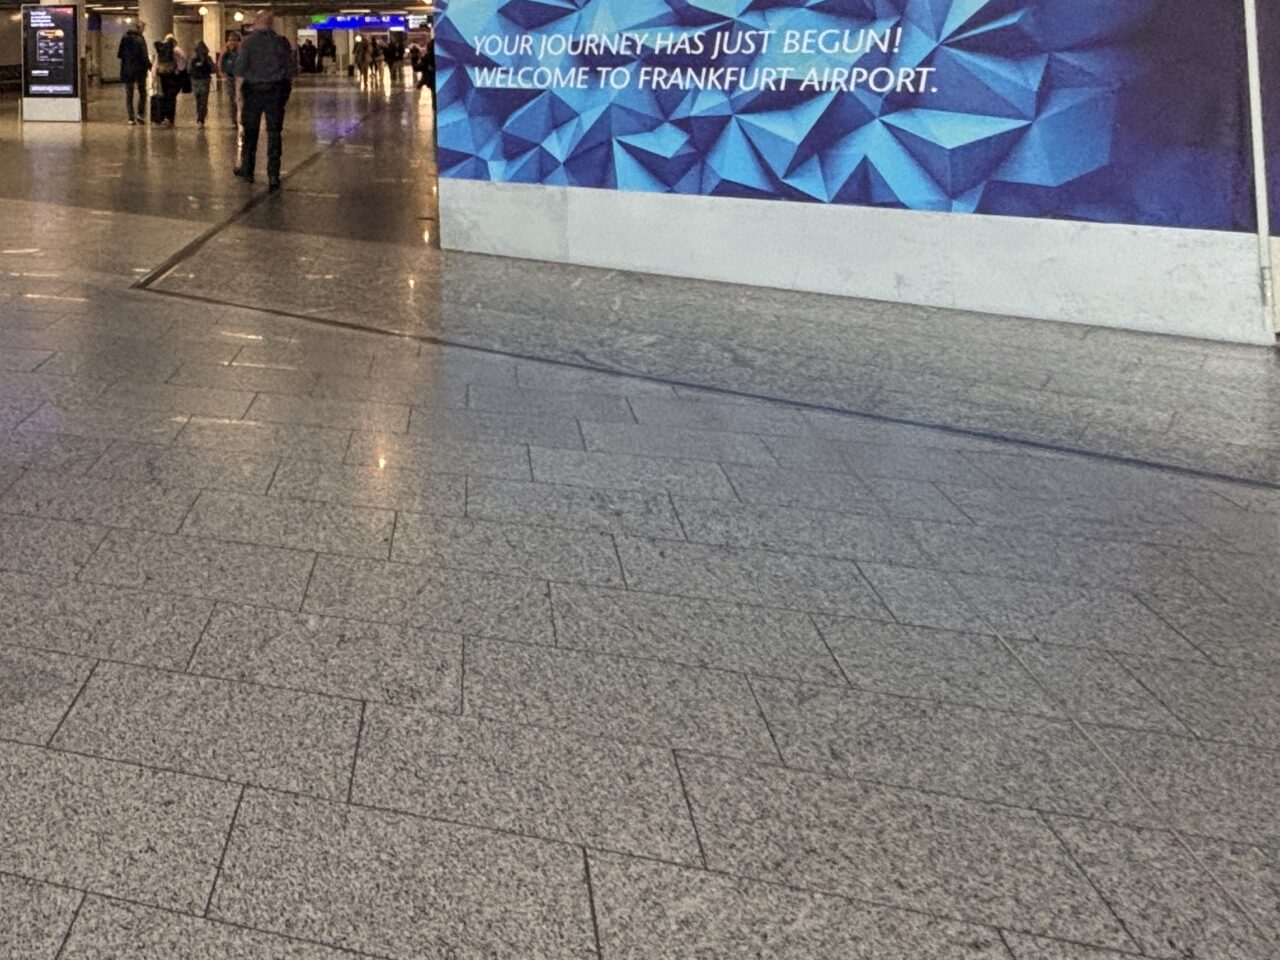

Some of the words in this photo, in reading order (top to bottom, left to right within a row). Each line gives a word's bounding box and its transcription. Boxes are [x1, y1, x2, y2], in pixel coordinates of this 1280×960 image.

[473, 33, 532, 56] YOUR
[539, 32, 646, 60] JOURNEY
[653, 31, 705, 56] HAS
[710, 30, 773, 60] JUST
[783, 27, 902, 55] BEGUN!
[473, 66, 597, 90] WELCOME
[599, 66, 631, 90] TO
[638, 66, 794, 92] FRANKFURT
[799, 66, 939, 93] AIRPORT.
